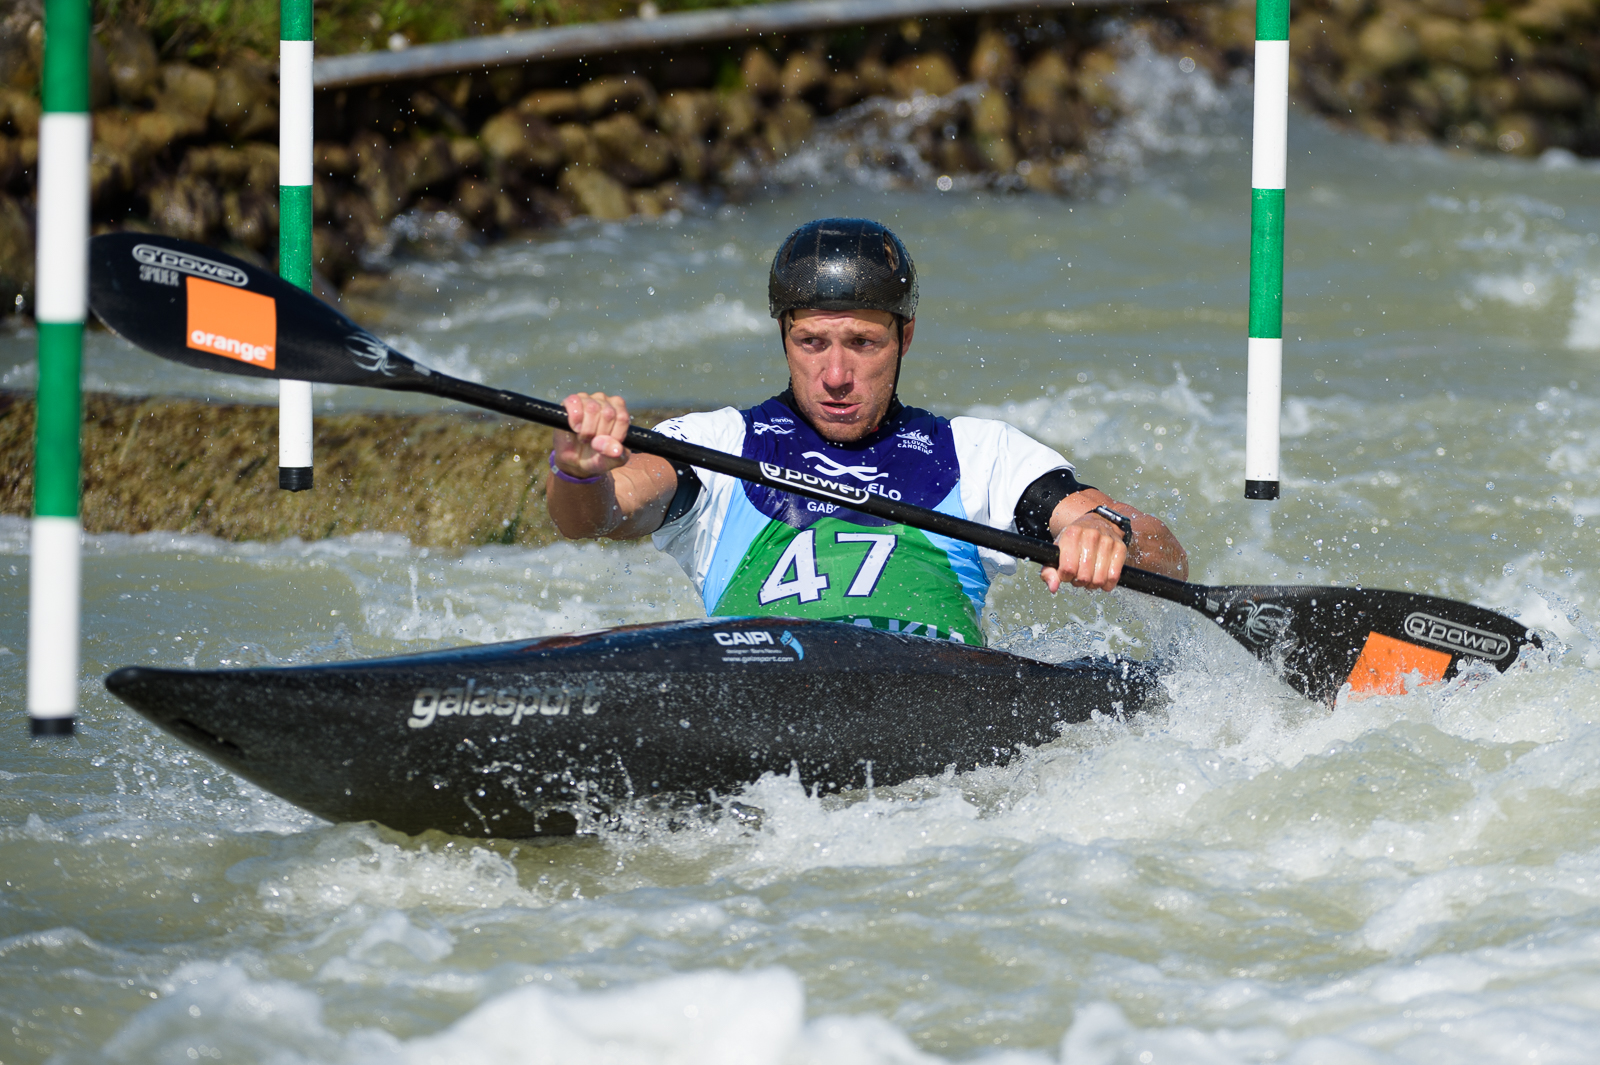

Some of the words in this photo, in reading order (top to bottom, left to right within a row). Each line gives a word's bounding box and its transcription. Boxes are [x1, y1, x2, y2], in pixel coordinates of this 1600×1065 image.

[191, 330, 267, 361] orange
[757, 528, 899, 607] 47
[713, 631, 775, 646] CAIPI
[407, 677, 601, 728] galasport
